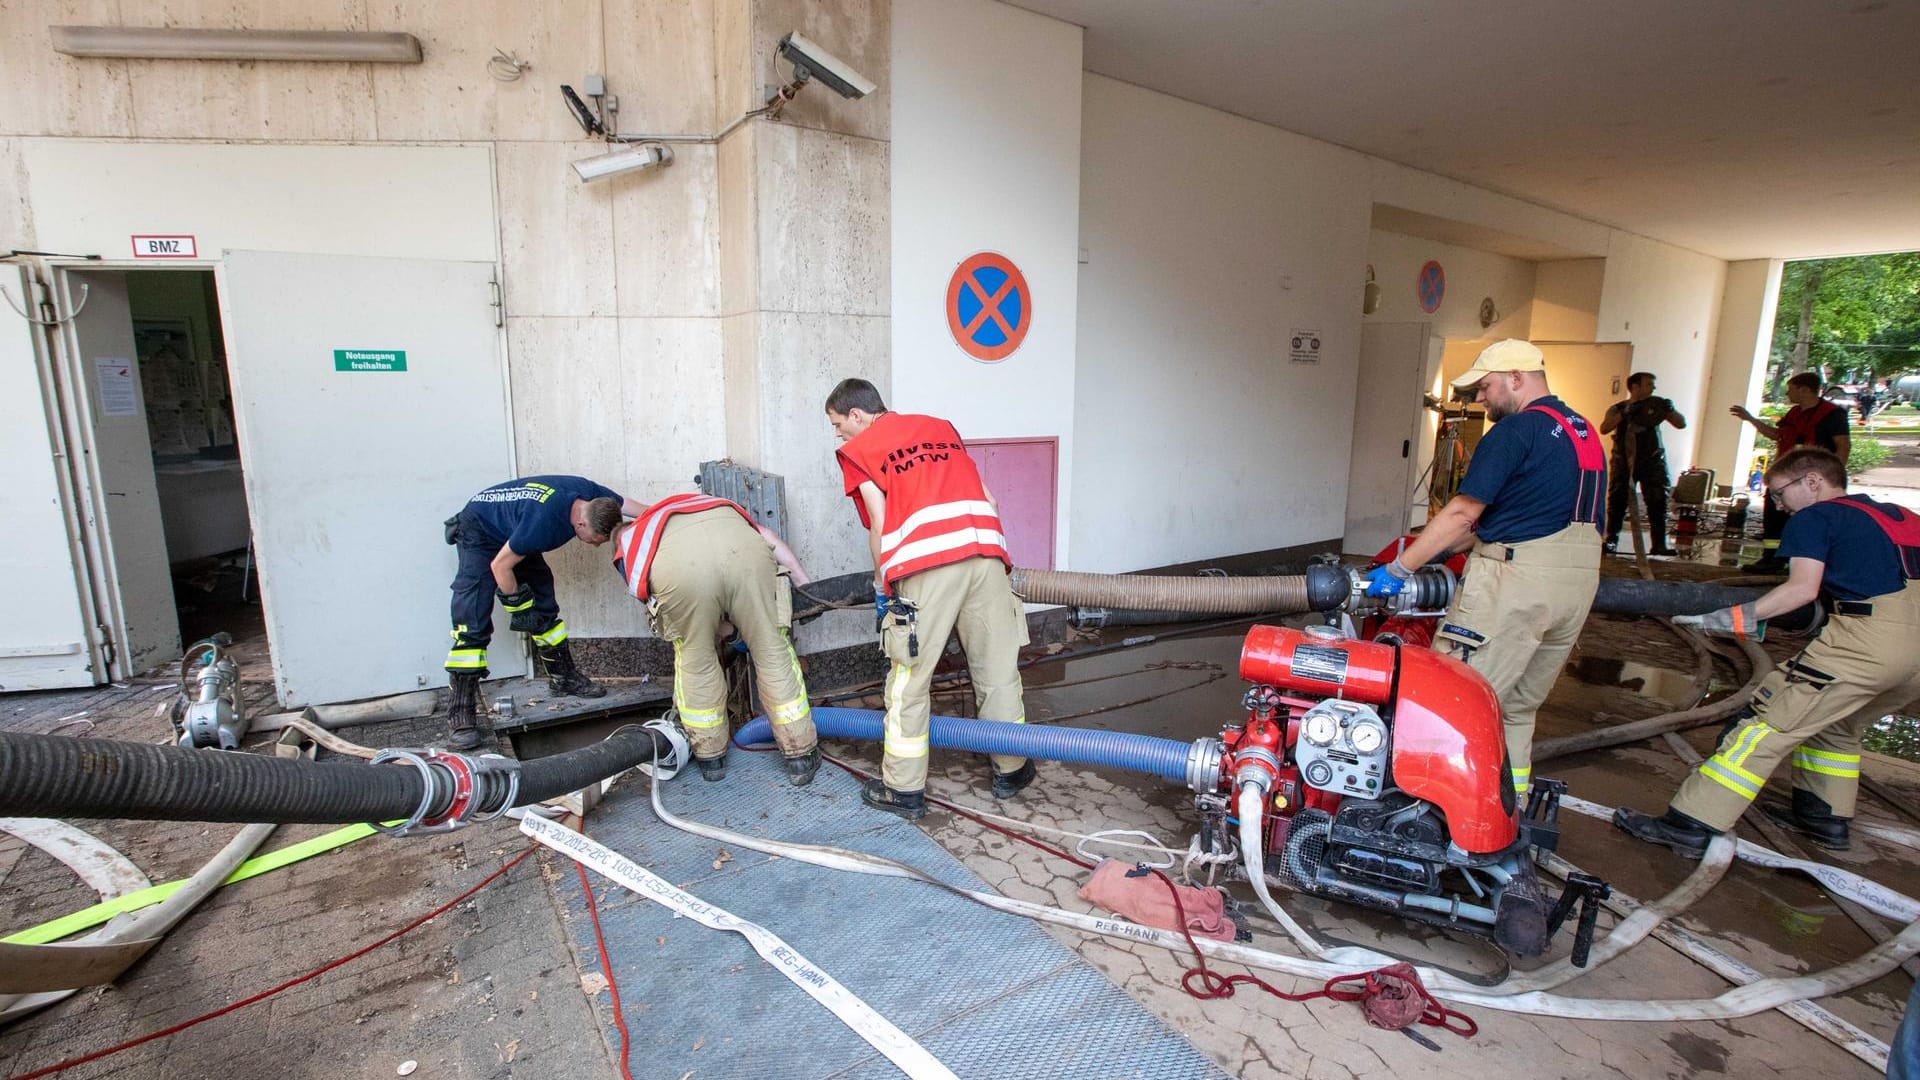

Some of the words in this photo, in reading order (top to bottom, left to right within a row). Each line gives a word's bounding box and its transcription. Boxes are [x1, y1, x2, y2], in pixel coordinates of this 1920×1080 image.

[148, 240, 181, 253] BMZ
[345, 351, 396, 362] Notausgang
[351, 361, 392, 370] freihalten
[894, 452, 949, 475] MTW
[1816, 867, 1906, 914] REG-HANN
[1095, 920, 1160, 942] REG-HANN
[770, 945, 830, 989] REG-HANN
